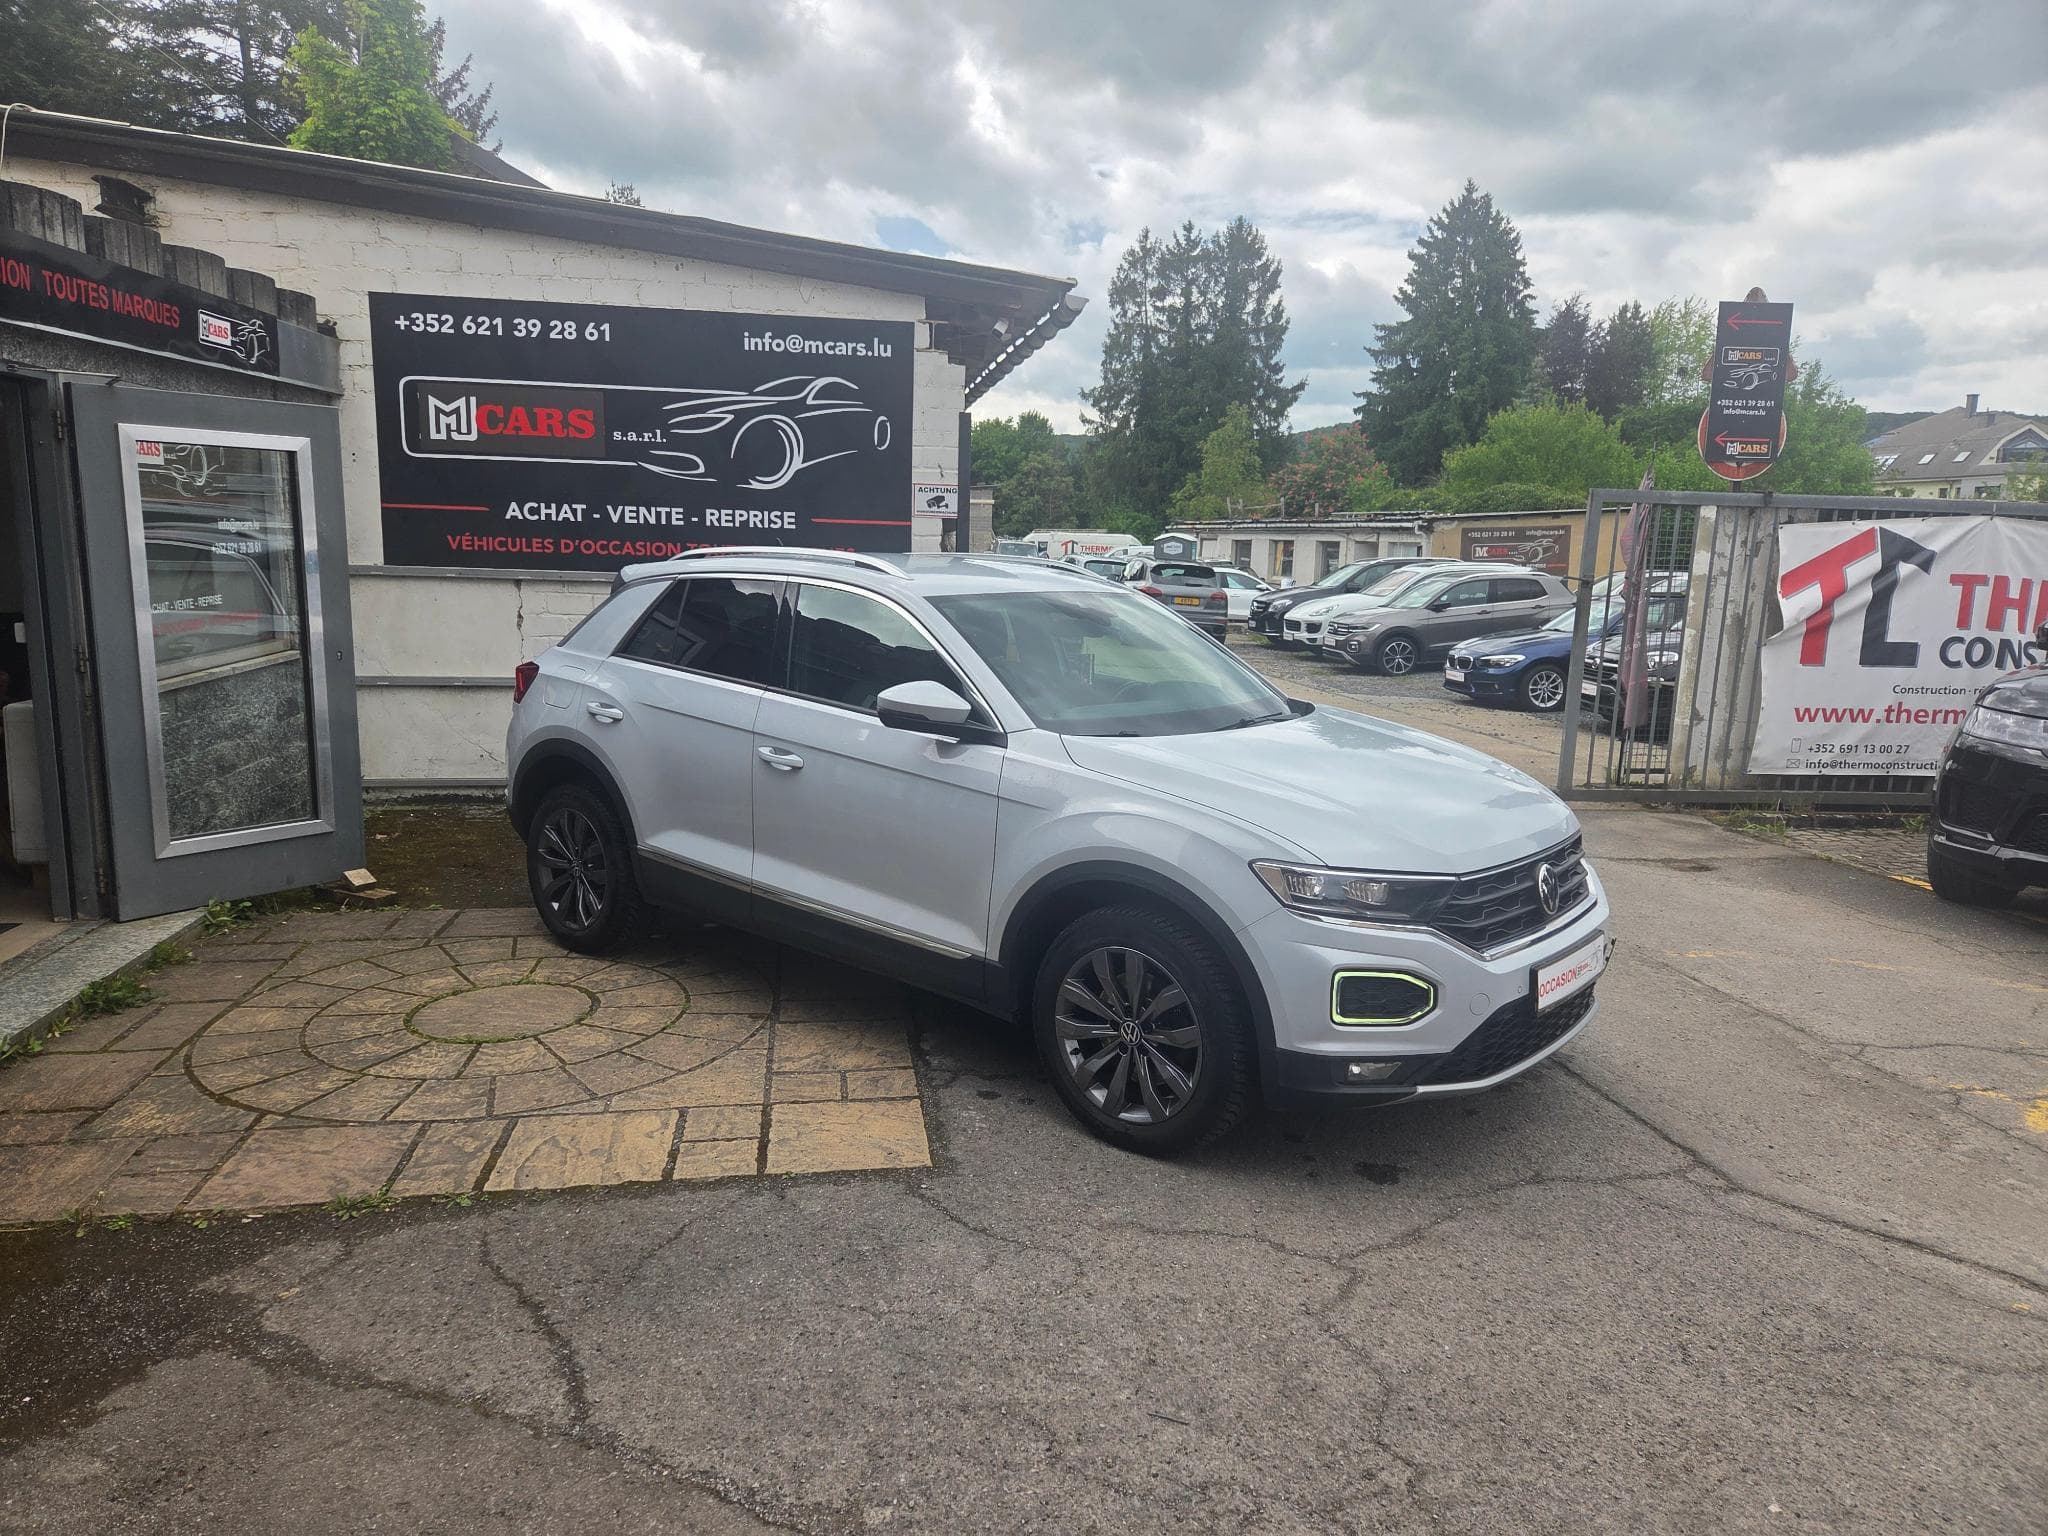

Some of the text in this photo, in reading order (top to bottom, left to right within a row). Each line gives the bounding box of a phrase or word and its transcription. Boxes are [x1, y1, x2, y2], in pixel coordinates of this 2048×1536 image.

[42, 270, 109, 310] TOUTES
[112, 289, 181, 328] MARQUES
[394, 312, 610, 342] +352 621 39 28 61
[743, 332, 892, 358] info@mcars.lu
[613, 430, 667, 443] s.a.r.l.
[918, 486, 958, 494] ACHTUNG
[505, 501, 587, 522] ACHAT
[606, 505, 684, 526] VENTE
[705, 508, 796, 529] REPRISE
[447, 532, 554, 553] VÉHICULES
[560, 538, 681, 557] D'OCCASION
[1892, 684, 1966, 697] Construction
[1808, 744, 1910, 754] +352 691 13 00 27
[1540, 968, 1577, 998] OCCASION
